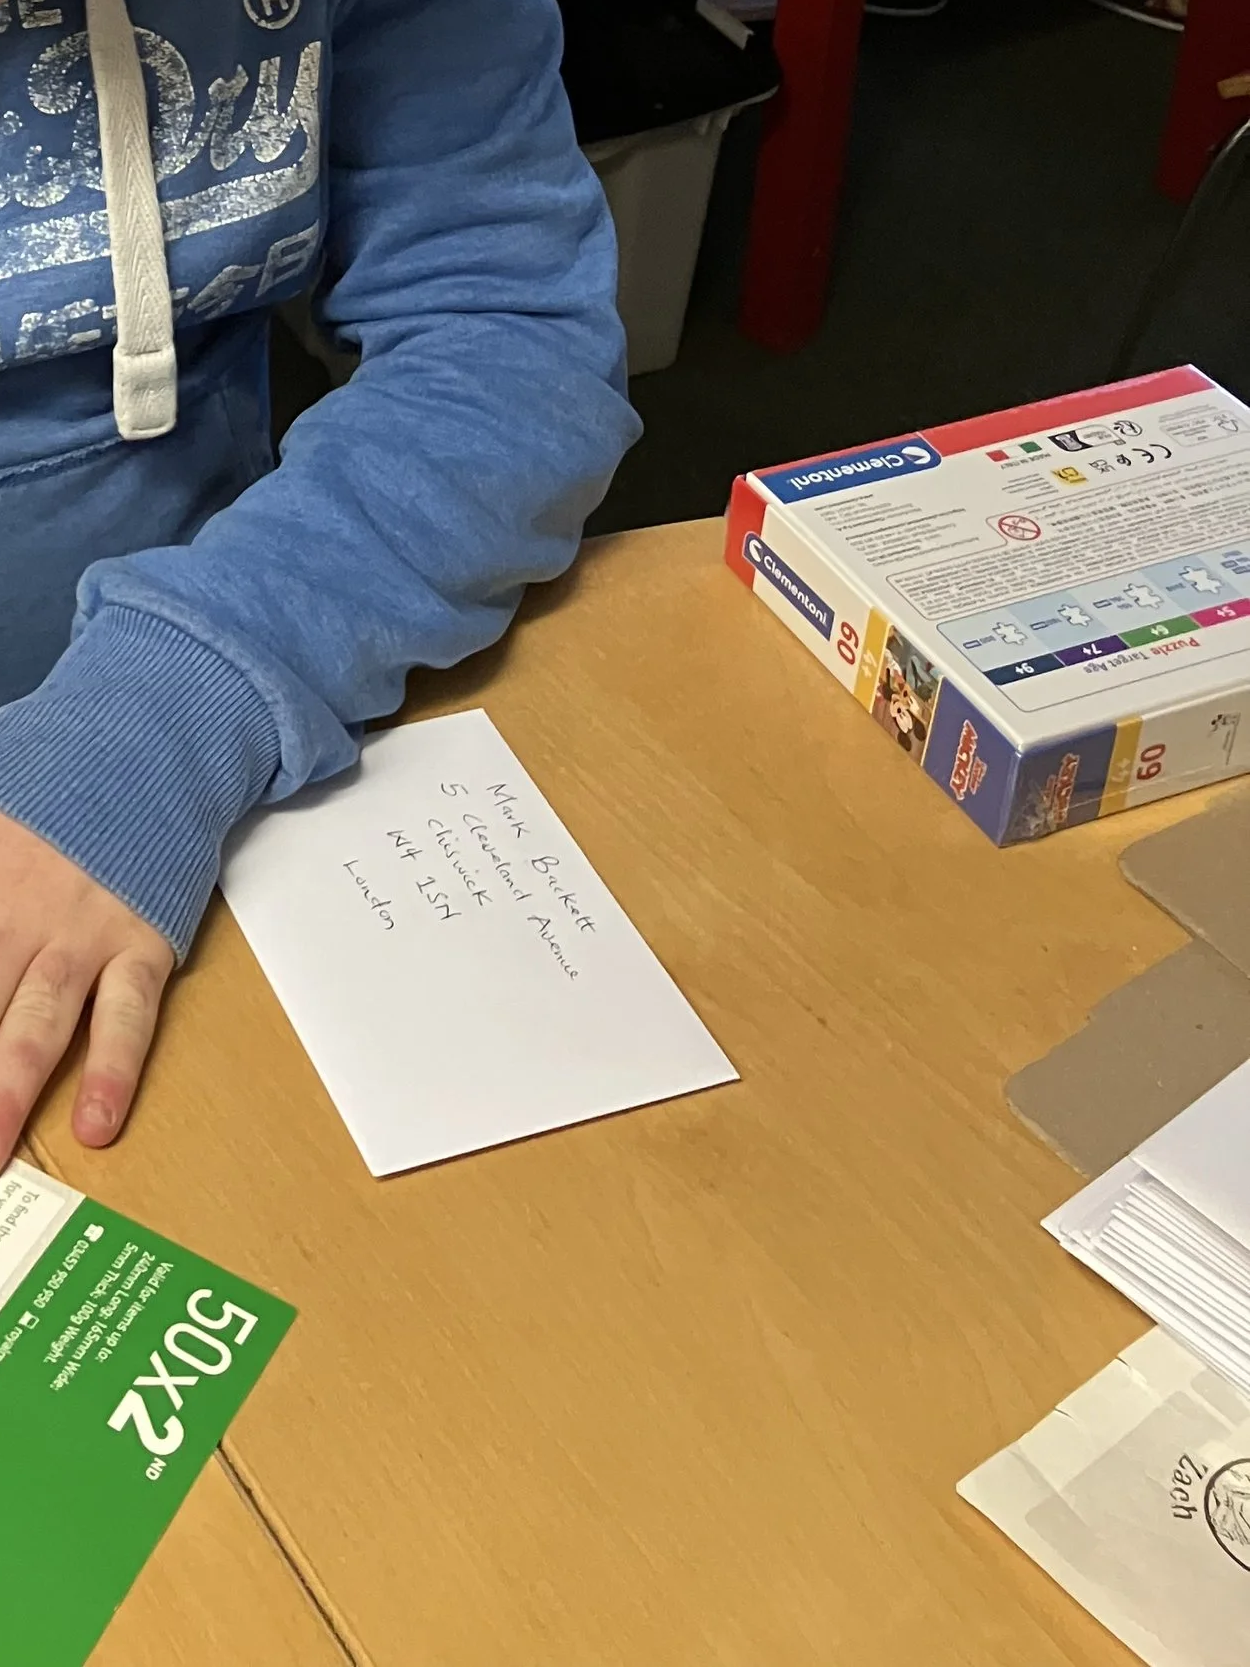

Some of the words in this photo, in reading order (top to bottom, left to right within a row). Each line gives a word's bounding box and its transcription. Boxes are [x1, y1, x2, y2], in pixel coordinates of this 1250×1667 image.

[791, 452, 905, 491] Clementoni
[763, 555, 828, 626] Clementoni
[837, 621, 860, 666] 60
[1082, 643, 1103, 657] 7+
[1150, 637, 1201, 656] Puzzle
[1014, 661, 1035, 674] 9+
[1083, 658, 1109, 675] Age
[1107, 648, 1149, 671] Target
[950, 719, 979, 802] MICKEY
[1136, 742, 1166, 781] 60
[486, 782, 531, 838] Mark
[440, 782, 469, 797] 5
[463, 813, 533, 902] Cleveland
[527, 914, 579, 982] Avenue
[342, 859, 396, 931] London
[4, 1180, 23, 1199] for
[22, 1190, 40, 1205] To
[6, 1204, 29, 1228] find
[62, 1239, 89, 1271] 03457
[111, 1242, 139, 1269] 5mm
[47, 1269, 68, 1289] 950
[121, 1251, 155, 1290] 240mm
[148, 1263, 174, 1288] Valid
[33, 1288, 54, 1308] 950
[138, 1285, 156, 1303] for
[70, 1300, 98, 1325] 100g
[116, 1302, 145, 1332] items
[72, 1321, 107, 1360] 165mm
[106, 1331, 122, 1347] up
[94, 1347, 113, 1363] to:
[1170, 1453, 1209, 1520] Zach
